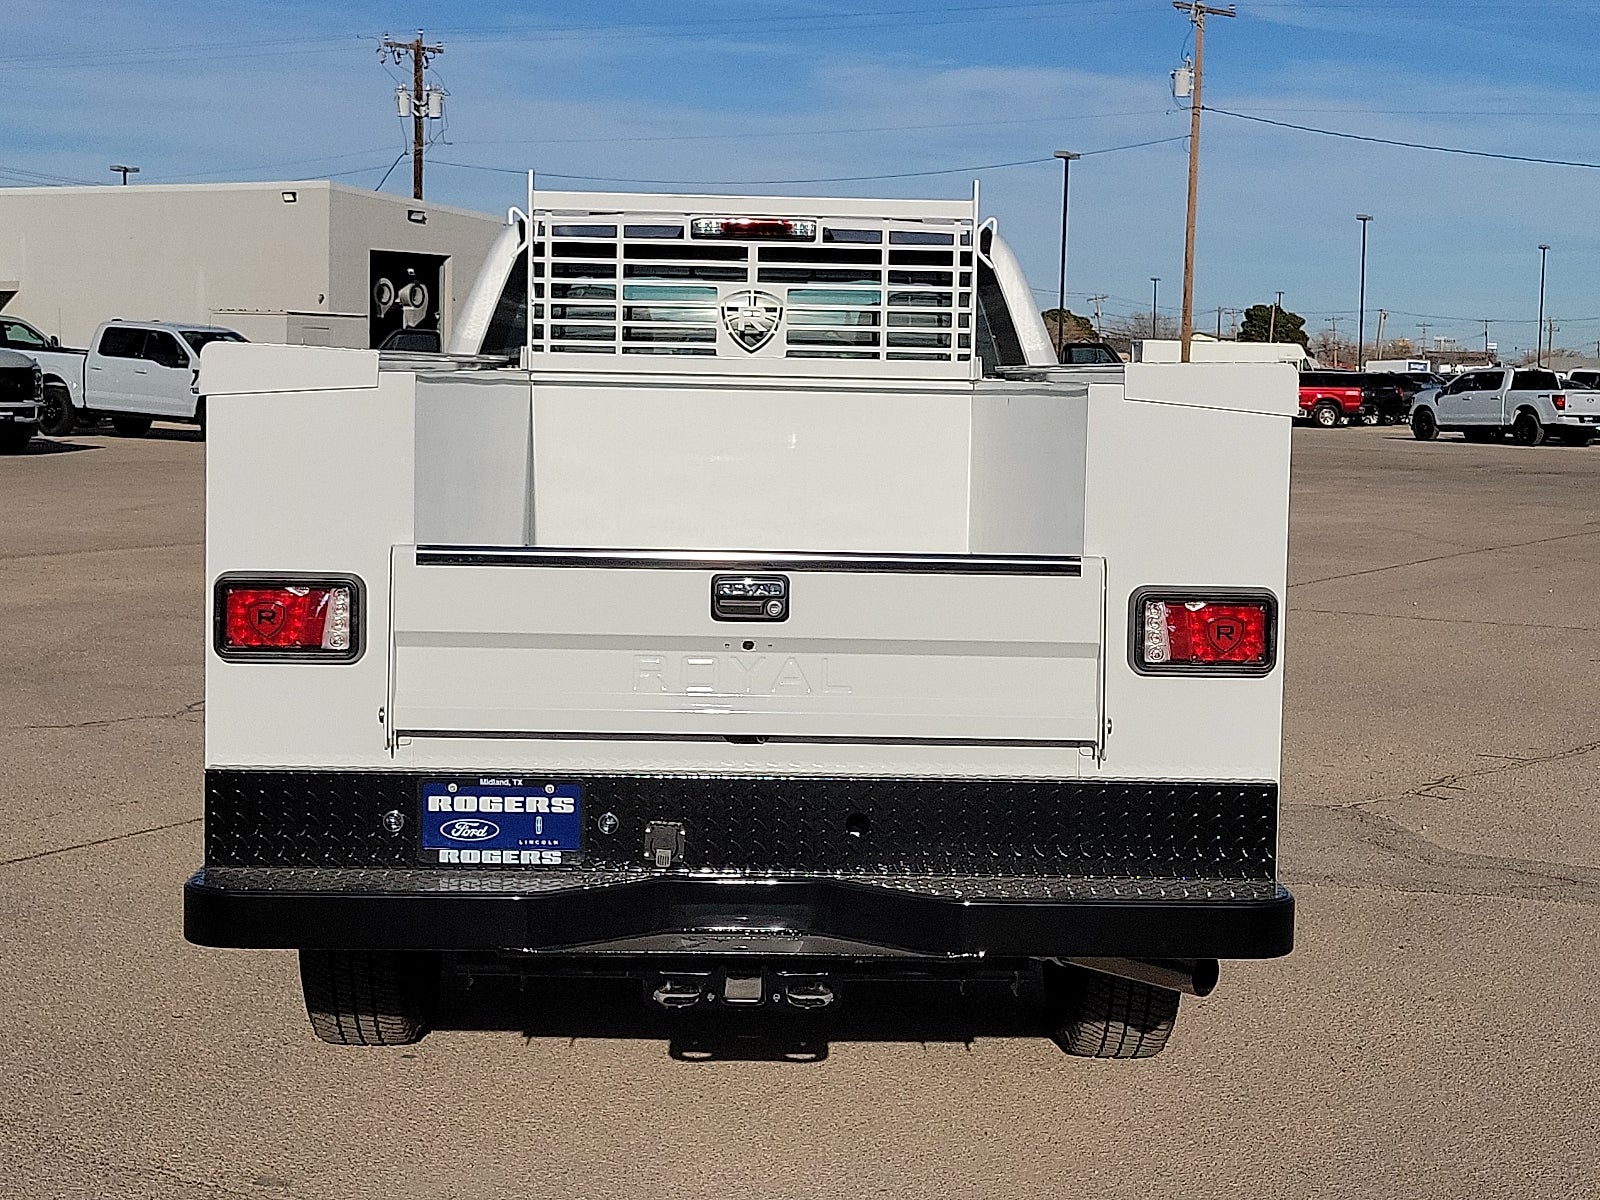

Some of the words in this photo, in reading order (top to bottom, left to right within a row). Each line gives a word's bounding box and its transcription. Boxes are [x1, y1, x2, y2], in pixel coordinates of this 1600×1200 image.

[257, 609, 277, 625] R
[1216, 625, 1235, 641] R
[632, 654, 853, 694] ROYAL
[479, 778, 512, 787] Midland,
[512, 778, 524, 786] TX
[427, 795, 575, 813] ROGERS
[450, 821, 489, 838] Ford
[438, 849, 562, 865] ROGERS
